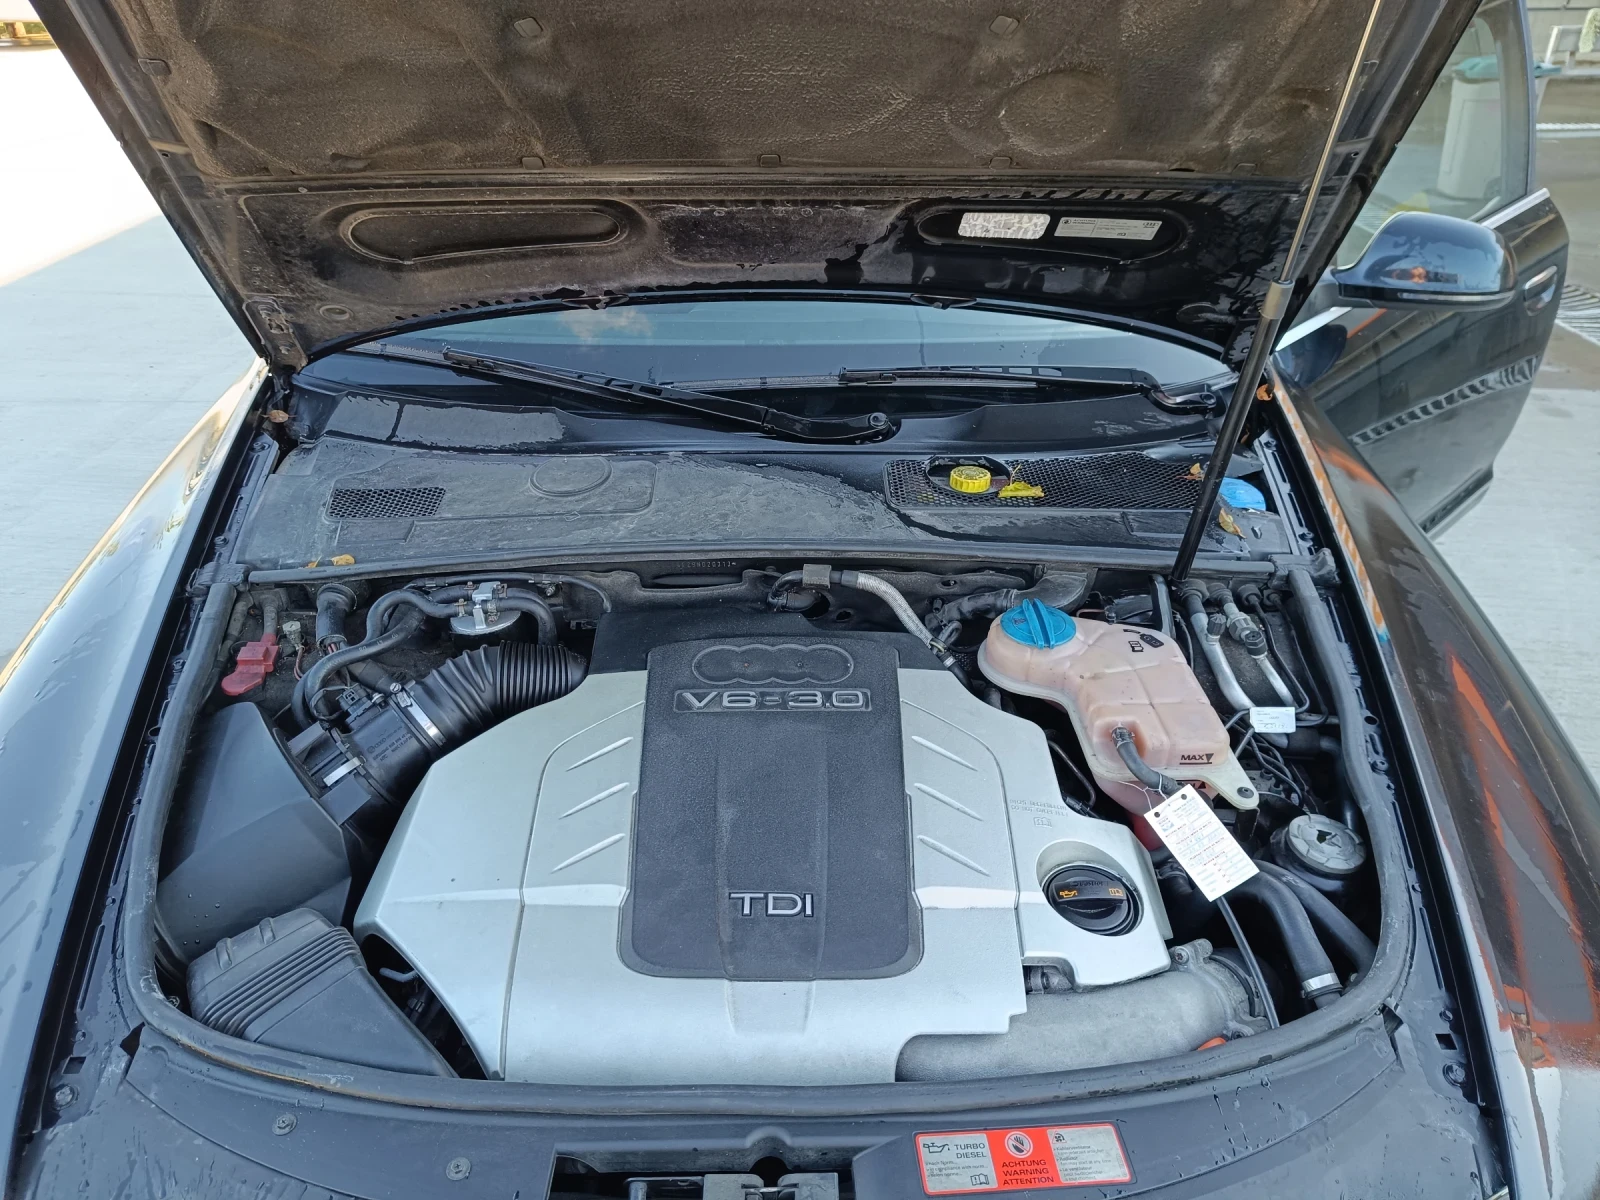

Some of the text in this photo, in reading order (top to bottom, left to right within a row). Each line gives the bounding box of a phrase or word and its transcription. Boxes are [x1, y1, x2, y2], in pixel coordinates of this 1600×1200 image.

[1180, 753, 1205, 761] MAX
[729, 892, 814, 917] TDI
[1002, 1159, 1047, 1168] ACHTUNG
[1002, 1168, 1049, 1177] WARNING
[1003, 1176, 1055, 1186] ATTENTION
